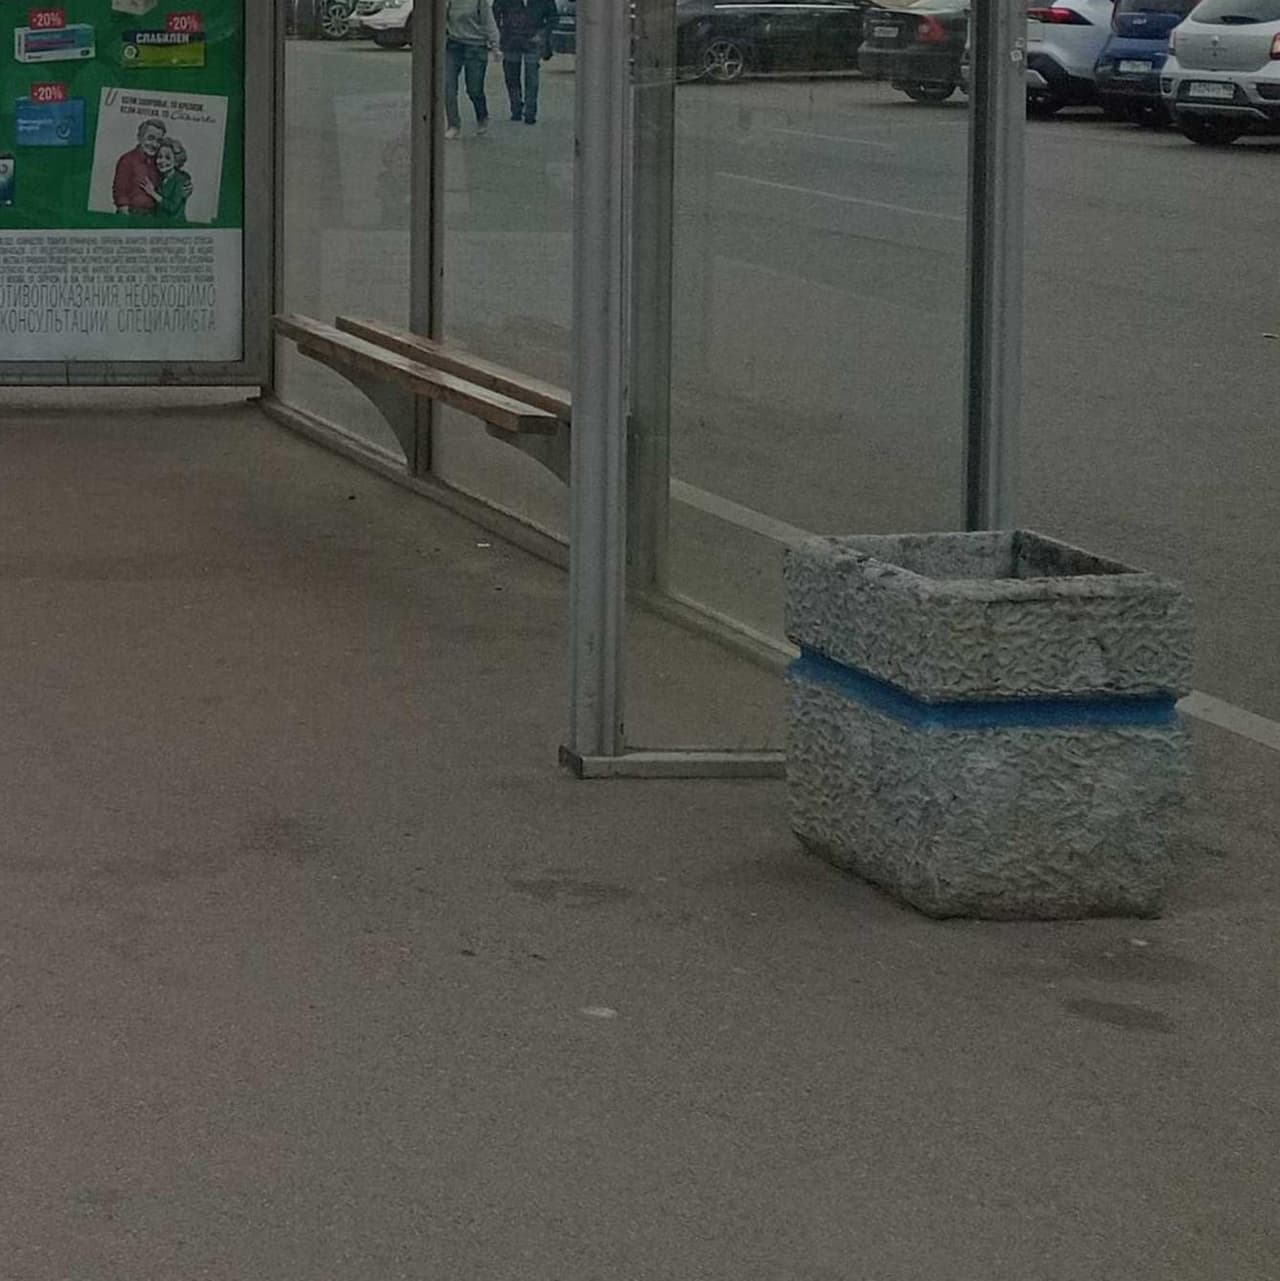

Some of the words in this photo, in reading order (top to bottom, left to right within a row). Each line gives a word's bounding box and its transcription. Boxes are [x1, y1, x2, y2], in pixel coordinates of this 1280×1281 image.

[31, 12, 63, 27] -20%
[168, 15, 199, 31] -20%
[135, 31, 190, 44] СЛАБИЛЕН
[32, 86, 63, 101] -20%
[124, 283, 216, 308] НЕОБХОДИМО
[0, 308, 108, 335] КОНСУЛЬТАЦИИ
[117, 308, 216, 334] СПЕЦИАЛИСТА
